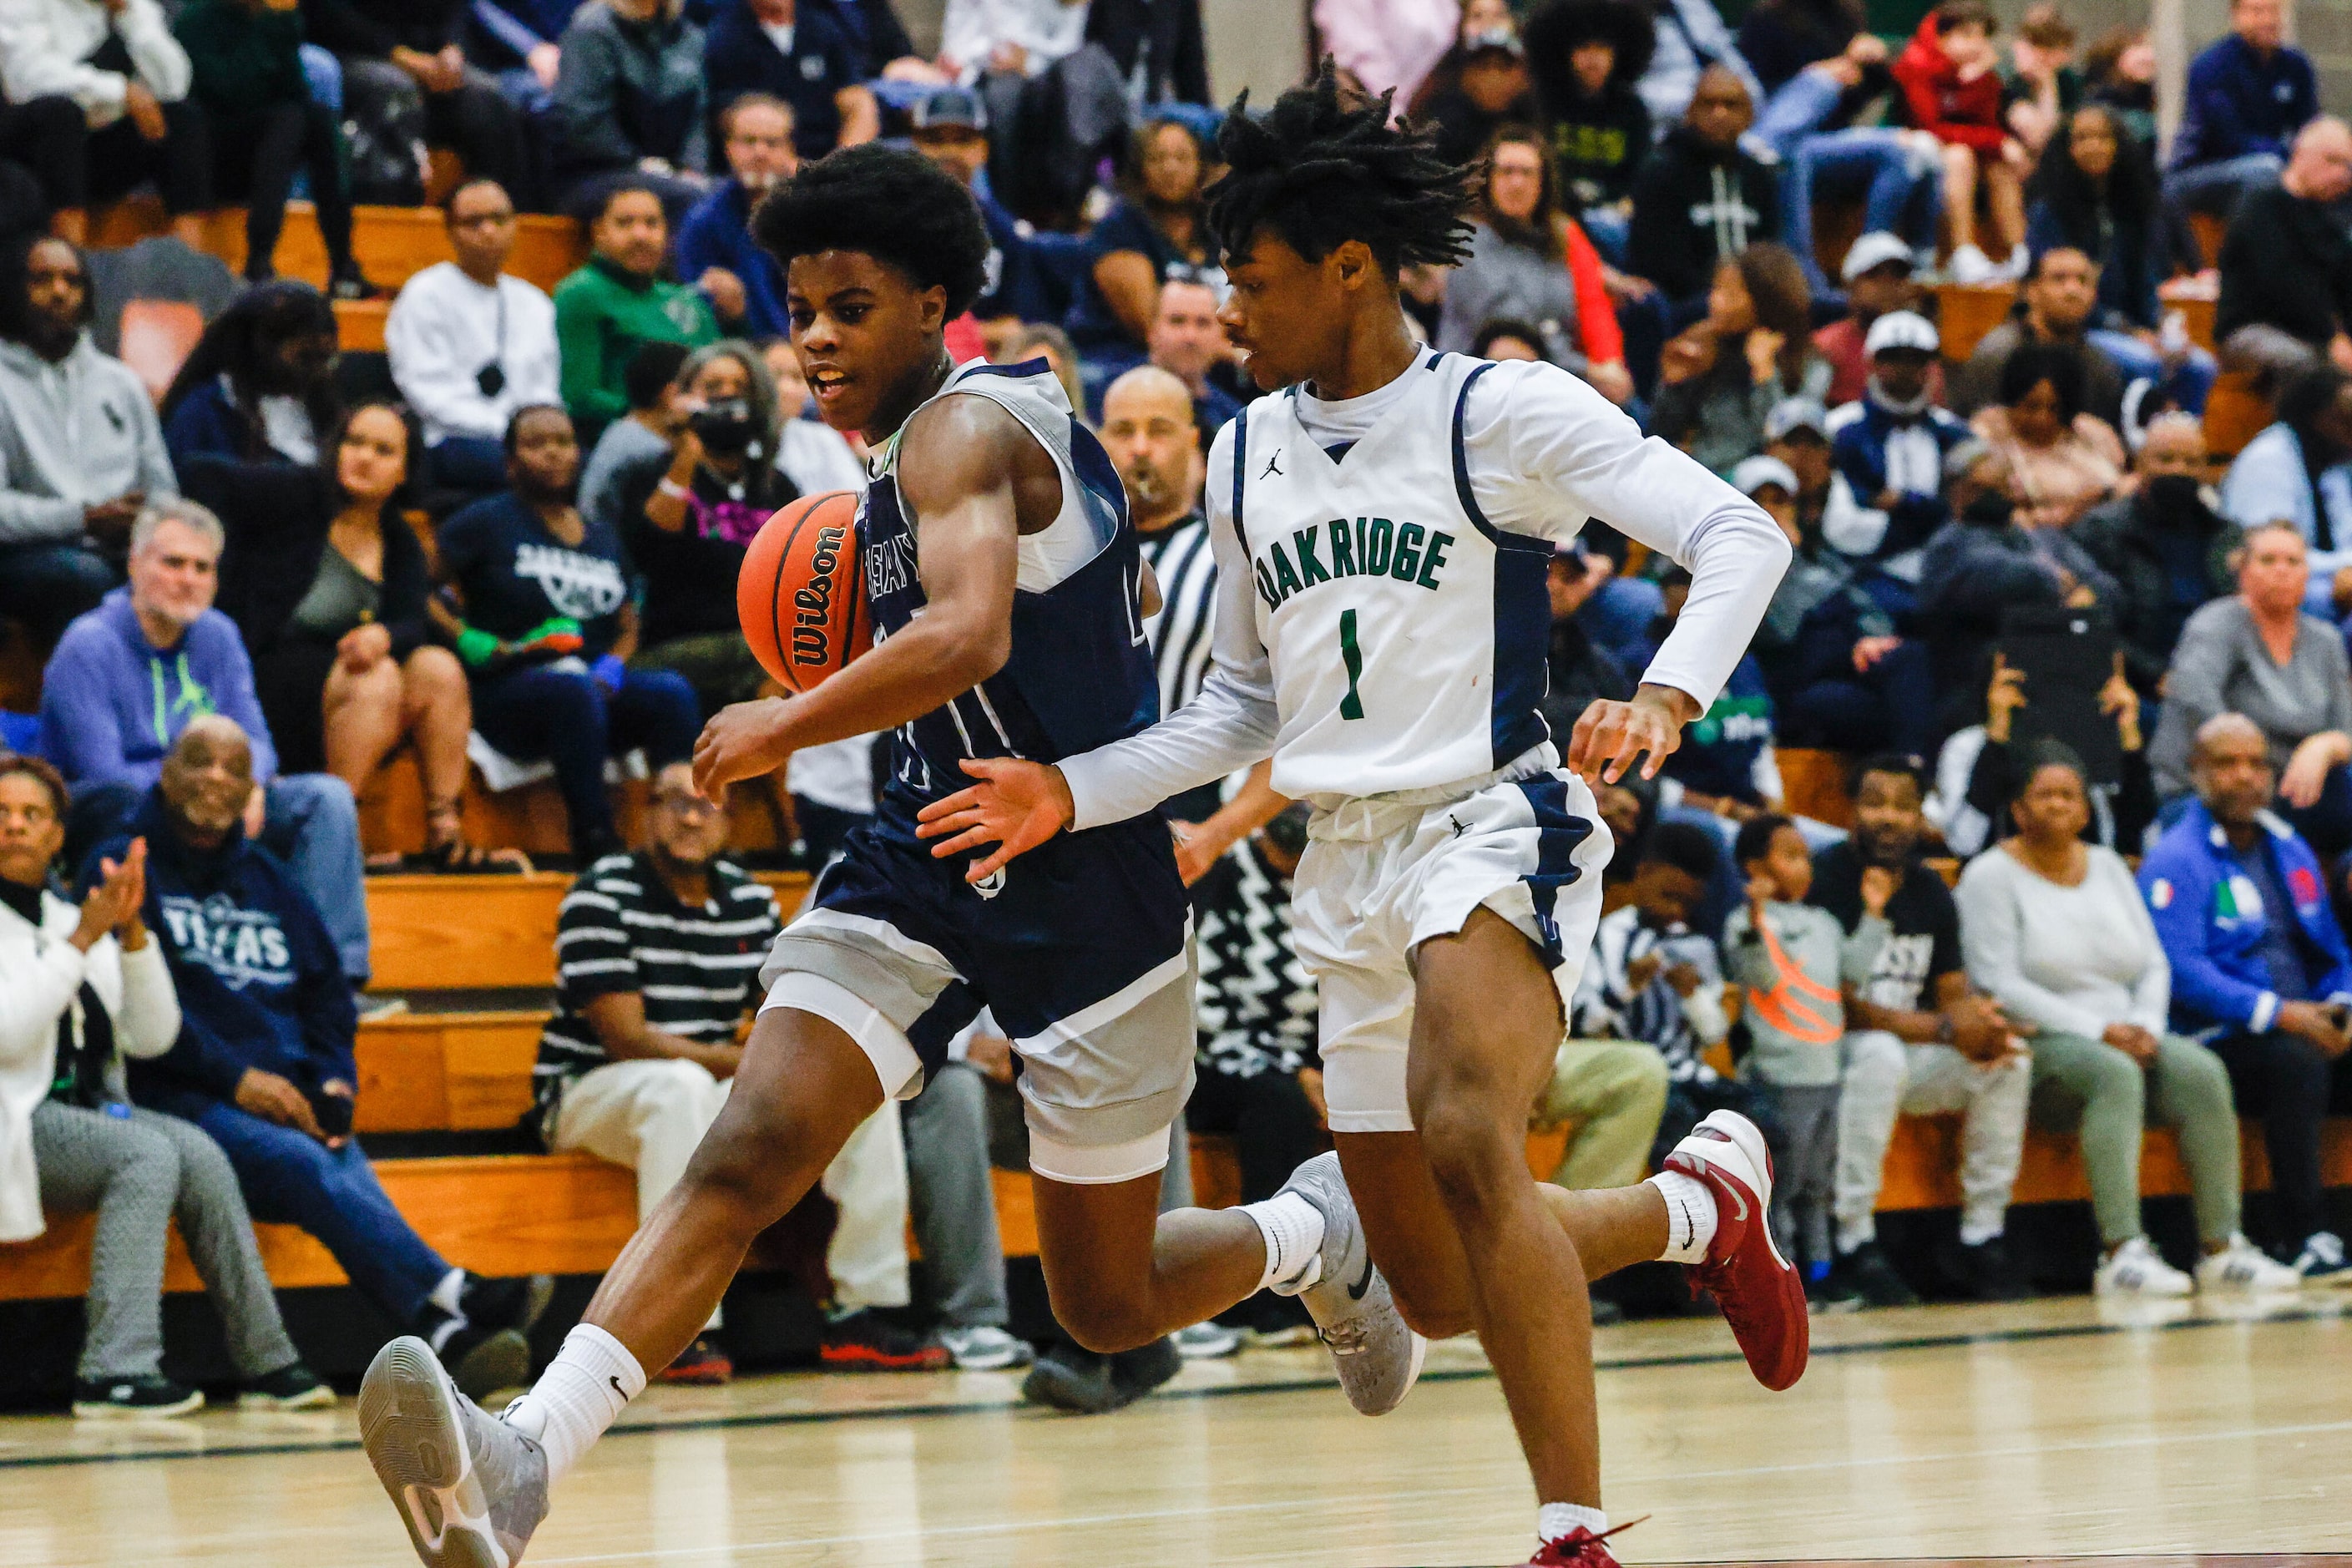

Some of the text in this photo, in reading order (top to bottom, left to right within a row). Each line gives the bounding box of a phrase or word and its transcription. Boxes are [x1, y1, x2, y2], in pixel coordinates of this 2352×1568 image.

[792, 526, 847, 667] Wilson
[1255, 516, 1456, 615] OAKRIDGE
[1338, 608, 1365, 721] 1
